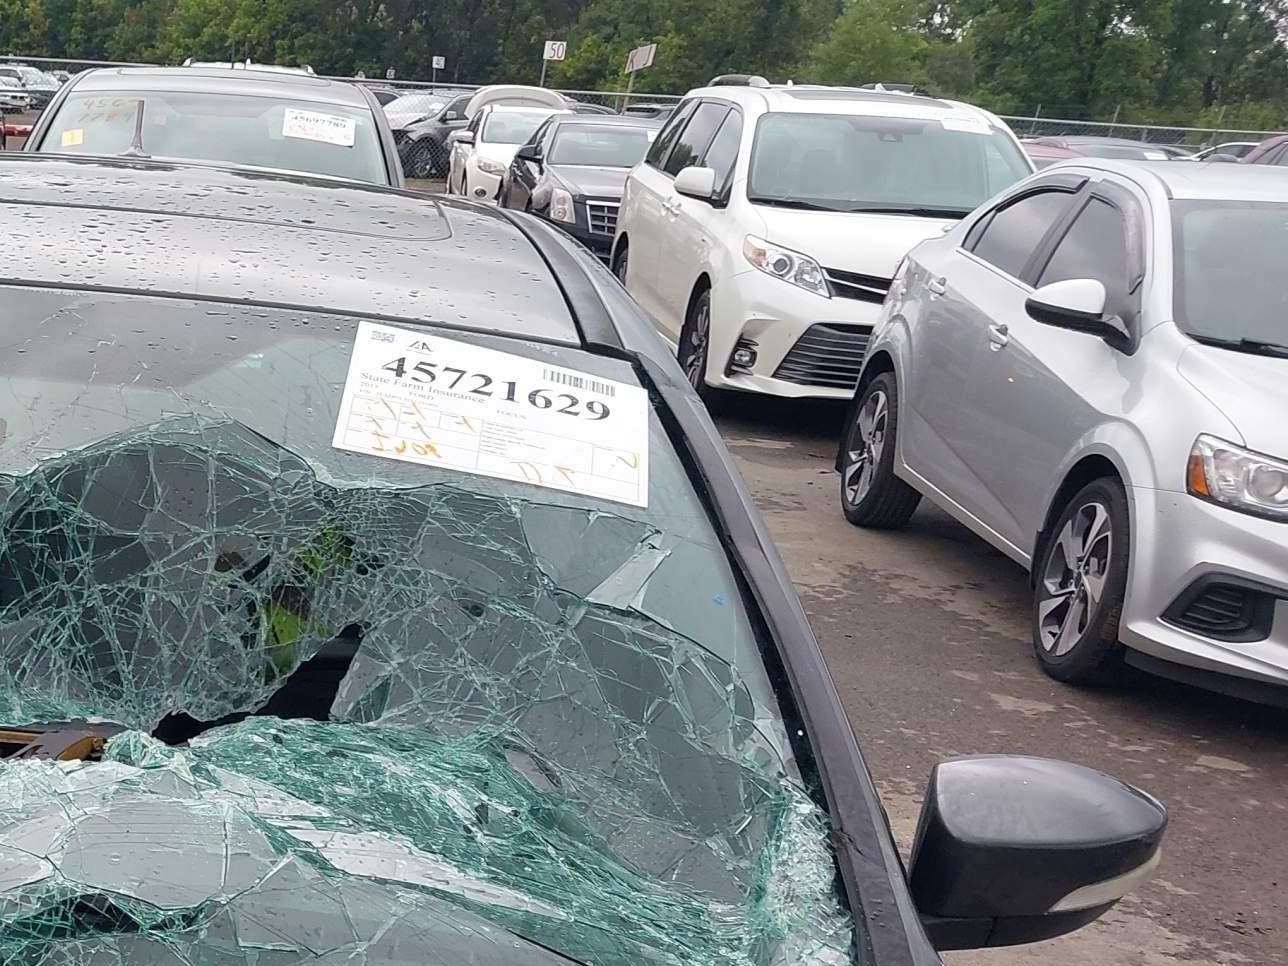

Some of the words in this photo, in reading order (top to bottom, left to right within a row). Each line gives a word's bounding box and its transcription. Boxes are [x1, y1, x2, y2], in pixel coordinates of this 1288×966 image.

[549, 43, 565, 59] 50
[360, 372, 391, 384] State
[393, 379, 424, 391] Farm
[428, 385, 486, 403] Insurance
[381, 356, 610, 420] 45721629
